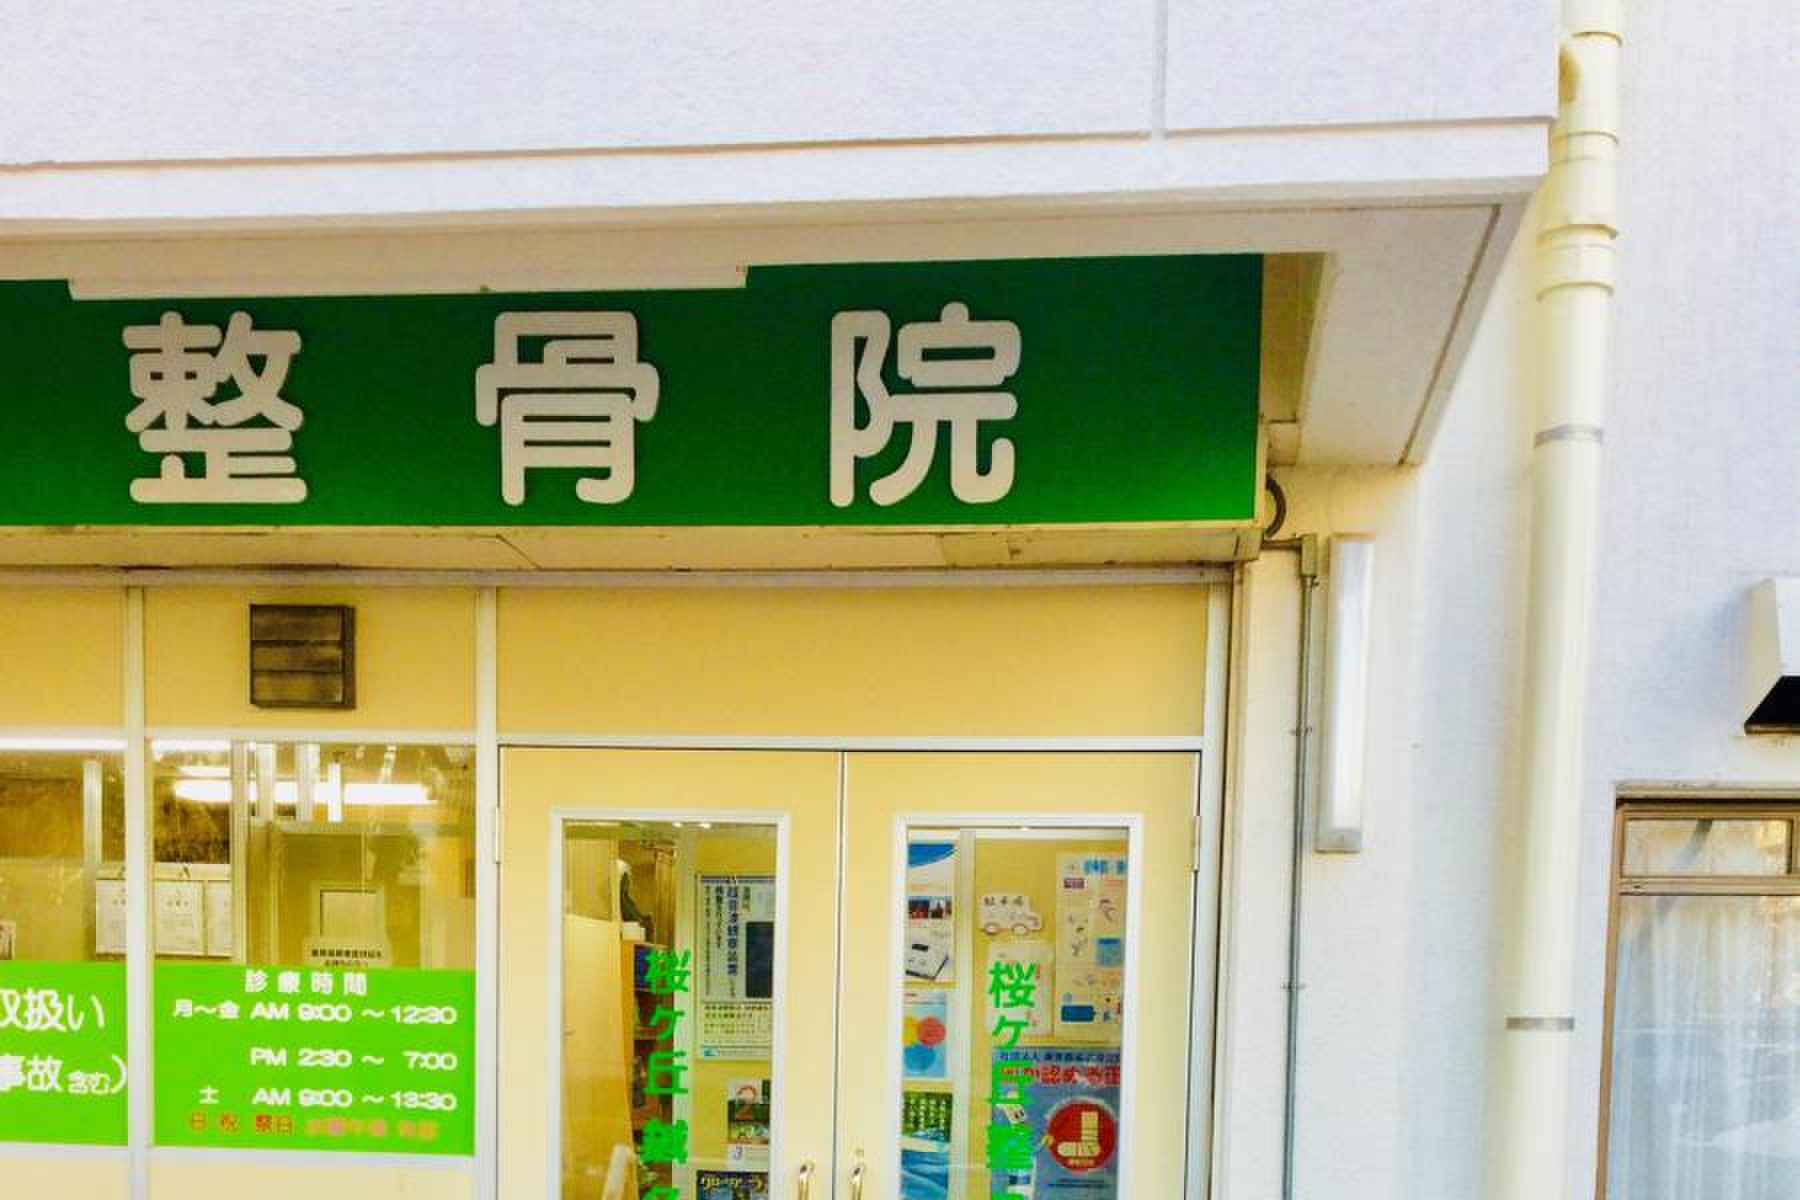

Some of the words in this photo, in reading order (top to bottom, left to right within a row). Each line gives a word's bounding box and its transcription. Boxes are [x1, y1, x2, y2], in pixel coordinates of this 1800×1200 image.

[122, 301, 1022, 508] 整骨院
[244, 969, 368, 996] 診療時間
[250, 1002, 289, 1020] AM
[390, 1004, 458, 1025] 12:30
[250, 1047, 288, 1066] PM
[297, 1048, 353, 1068] 2:30
[402, 1050, 458, 1071] 7:00
[200, 1086, 219, 1105] 土
[252, 1087, 292, 1106] AM
[390, 1090, 458, 1111] 13:30
